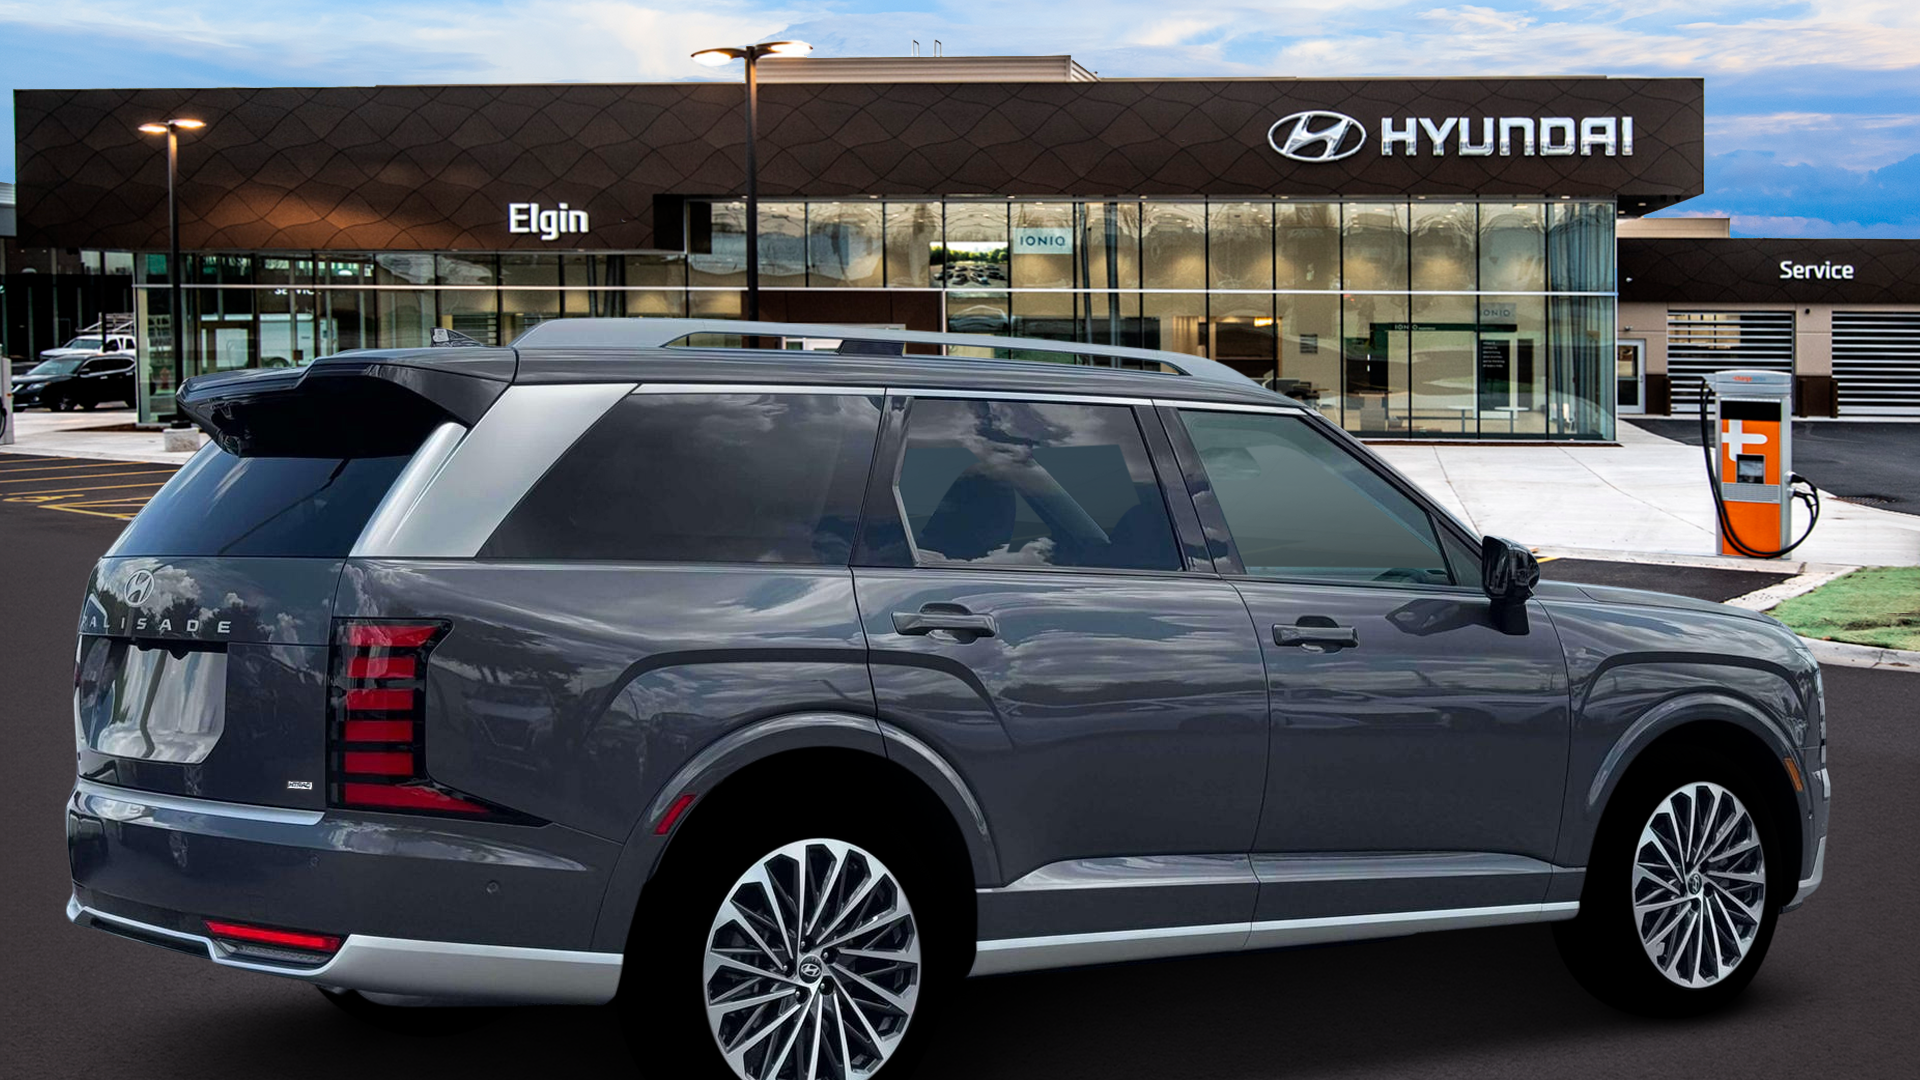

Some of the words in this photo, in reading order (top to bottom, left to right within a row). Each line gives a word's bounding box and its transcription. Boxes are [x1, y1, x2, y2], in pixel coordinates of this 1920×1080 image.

[1381, 117, 1633, 156] HYUNDAI
[508, 203, 589, 240] Elgin
[1020, 235, 1065, 246] IONIQ
[1779, 260, 1854, 279] Service
